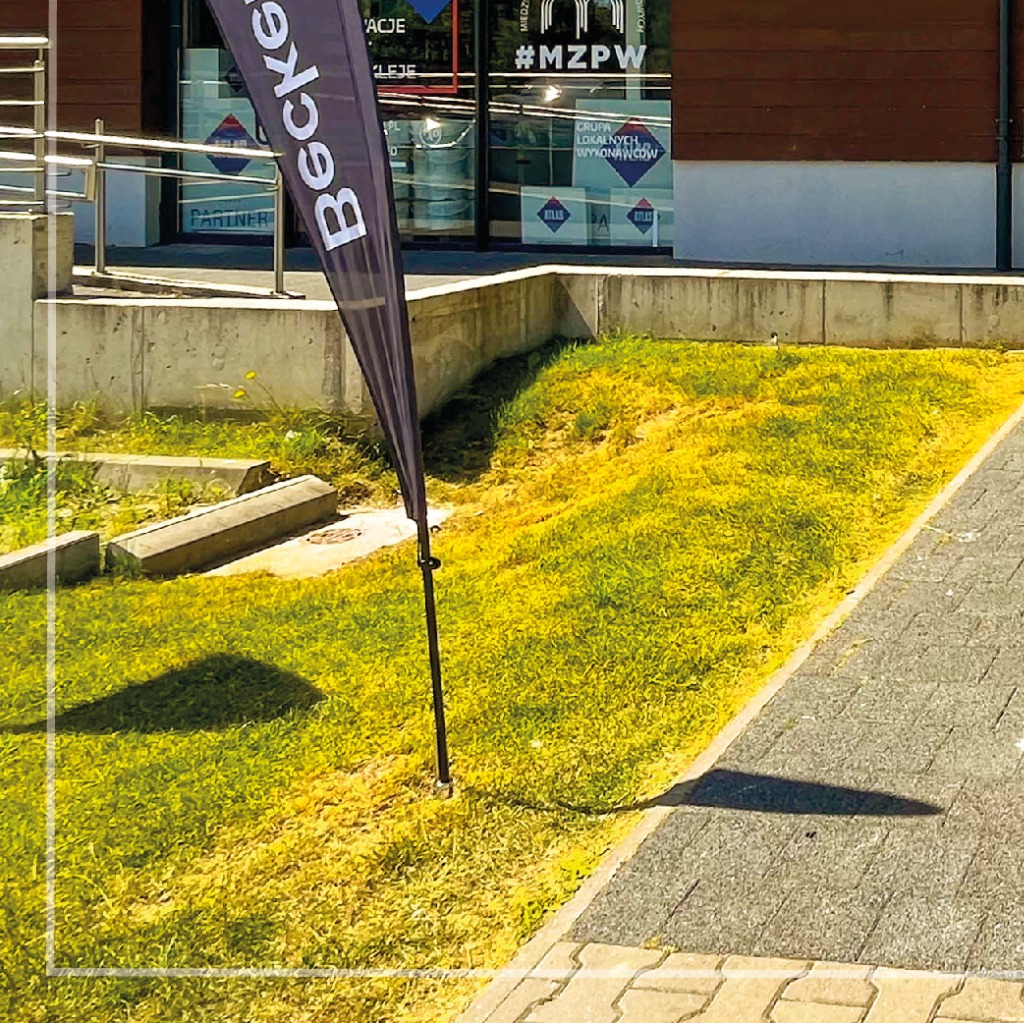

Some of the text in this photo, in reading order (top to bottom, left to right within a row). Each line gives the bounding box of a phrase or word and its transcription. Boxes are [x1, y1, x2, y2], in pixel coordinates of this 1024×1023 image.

[364, 18, 406, 34] ACJE
[514, 44, 647, 70] #MZPW
[576, 122, 612, 133] GRUPA
[576, 135, 638, 145] LOKALNYCH
[189, 208, 268, 227] PARTNER
